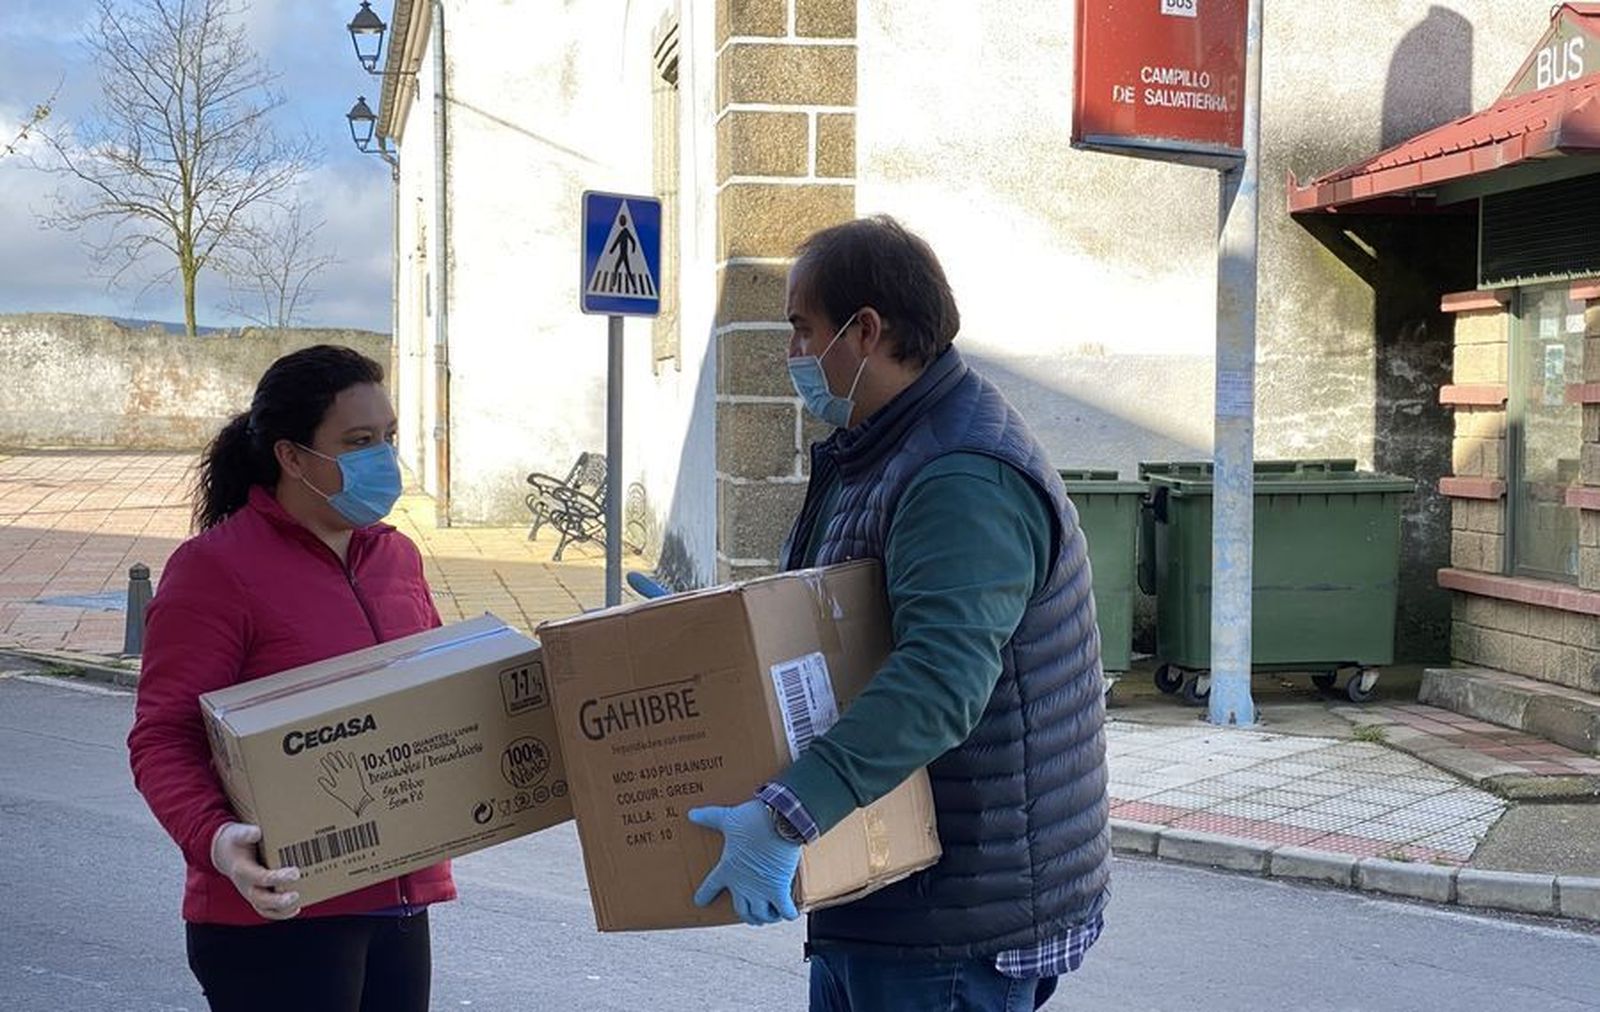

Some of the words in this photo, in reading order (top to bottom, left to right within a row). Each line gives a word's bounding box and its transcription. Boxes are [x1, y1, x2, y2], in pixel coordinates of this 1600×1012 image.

[1537, 36, 1584, 90] BUS
[1140, 66, 1210, 88] CAMPILLO
[1113, 85, 1135, 103] DE
[1144, 88, 1228, 112] SALVATIERRA
[579, 688, 700, 741] GAHIBRE
[361, 743, 411, 771] 10x100
[505, 743, 544, 767] 100%
[674, 756, 723, 774] RAINSUIT
[617, 787, 662, 805] COLOUR:
[665, 782, 704, 798] GREEN
[665, 806, 678, 818] XL
[660, 828, 673, 841] 10
